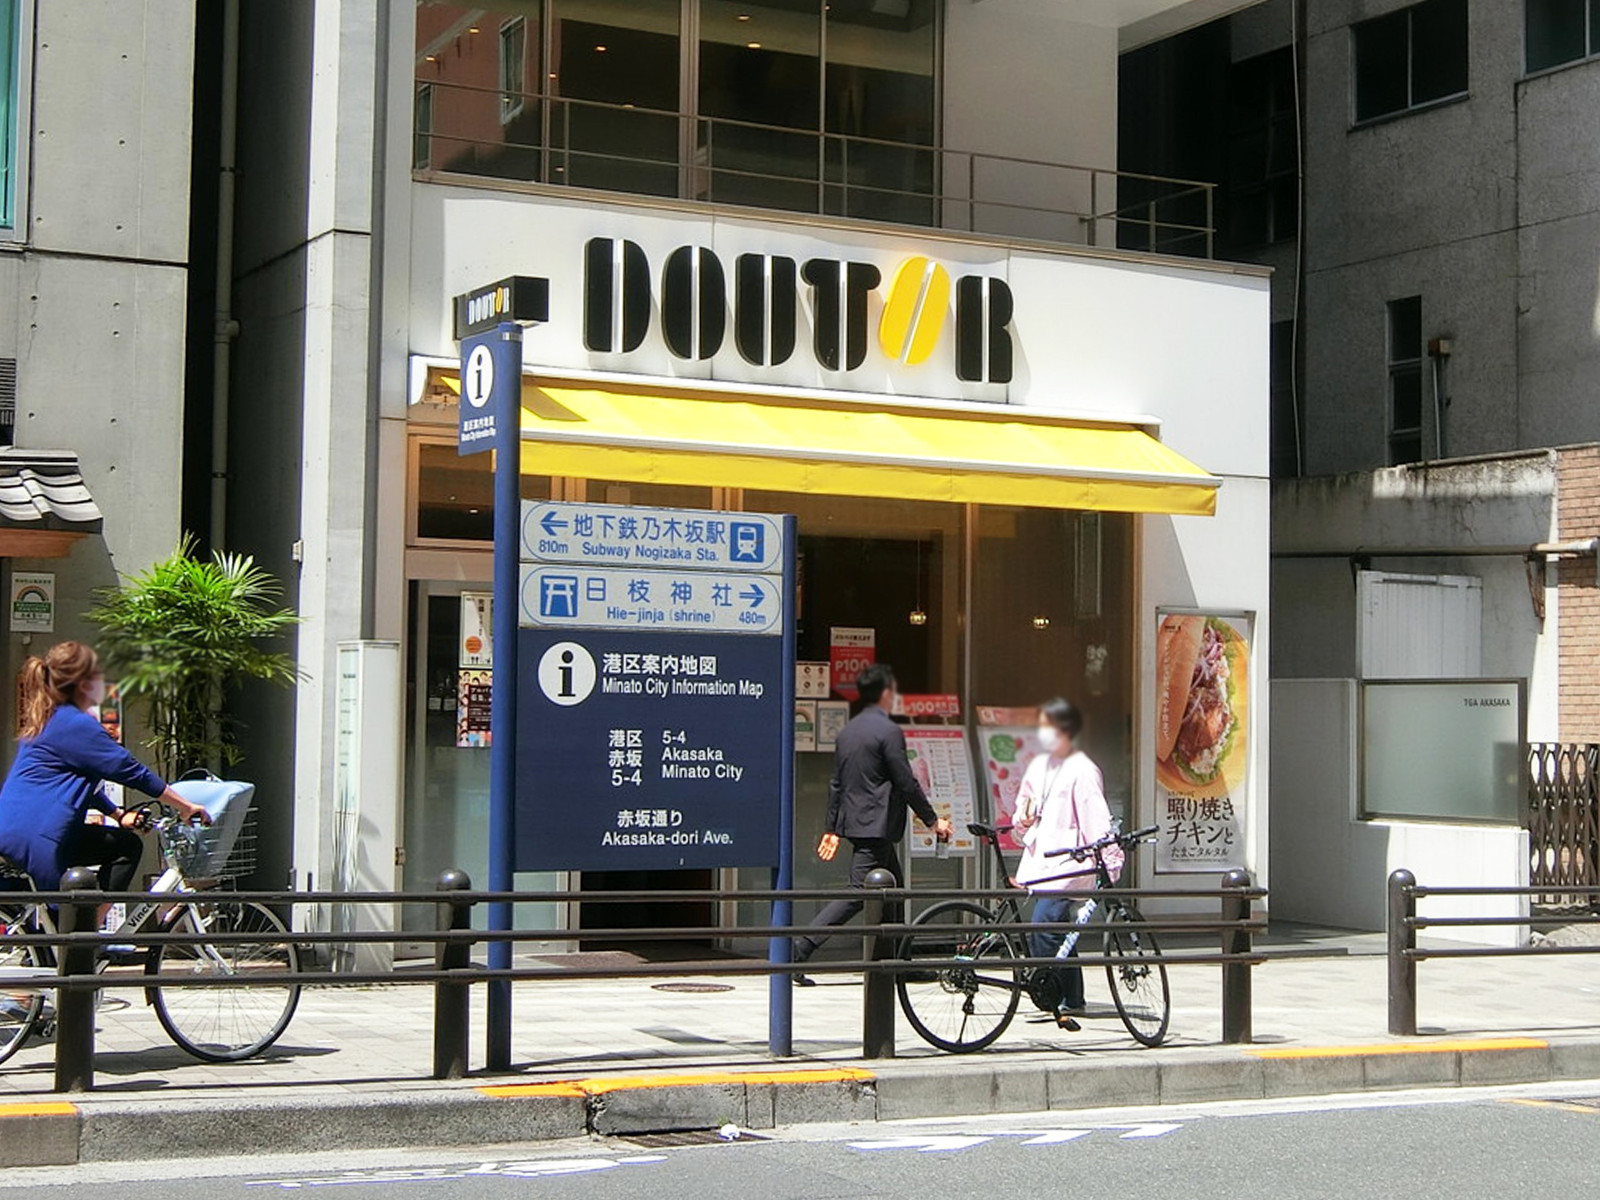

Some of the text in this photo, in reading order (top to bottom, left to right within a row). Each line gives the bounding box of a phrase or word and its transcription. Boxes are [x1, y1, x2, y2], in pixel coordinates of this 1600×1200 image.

[468, 287, 510, 326] DOUTOR
[582, 237, 1014, 384] DOUTOR
[572, 513, 726, 545] 地下鉄乃木坂駅
[538, 539, 569, 554] 810m
[582, 541, 719, 562] Subway Nogizaka Sta.
[586, 577, 733, 607] 日枝神社
[607, 606, 716, 624] Hie-jinja (shrine)
[738, 611, 767, 625] 480m
[602, 653, 717, 676] 港区案内地図
[602, 677, 764, 699] Minato City Information Map
[1480, 698, 1511, 707] AKASAKA
[608, 729, 643, 748] 港区
[662, 730, 687, 744] 5-4
[608, 750, 643, 768] 赤坂
[661, 747, 724, 761] Akasaka
[611, 769, 643, 786] 5-4
[662, 764, 744, 782] Minato City
[1166, 797, 1235, 821] 照り焼き
[617, 809, 683, 828] 赤坂通り
[601, 830, 734, 846] Akasaka-dori Ave.
[1166, 821, 1235, 845] チキンと
[1170, 846, 1230, 858] たまごタルタル
